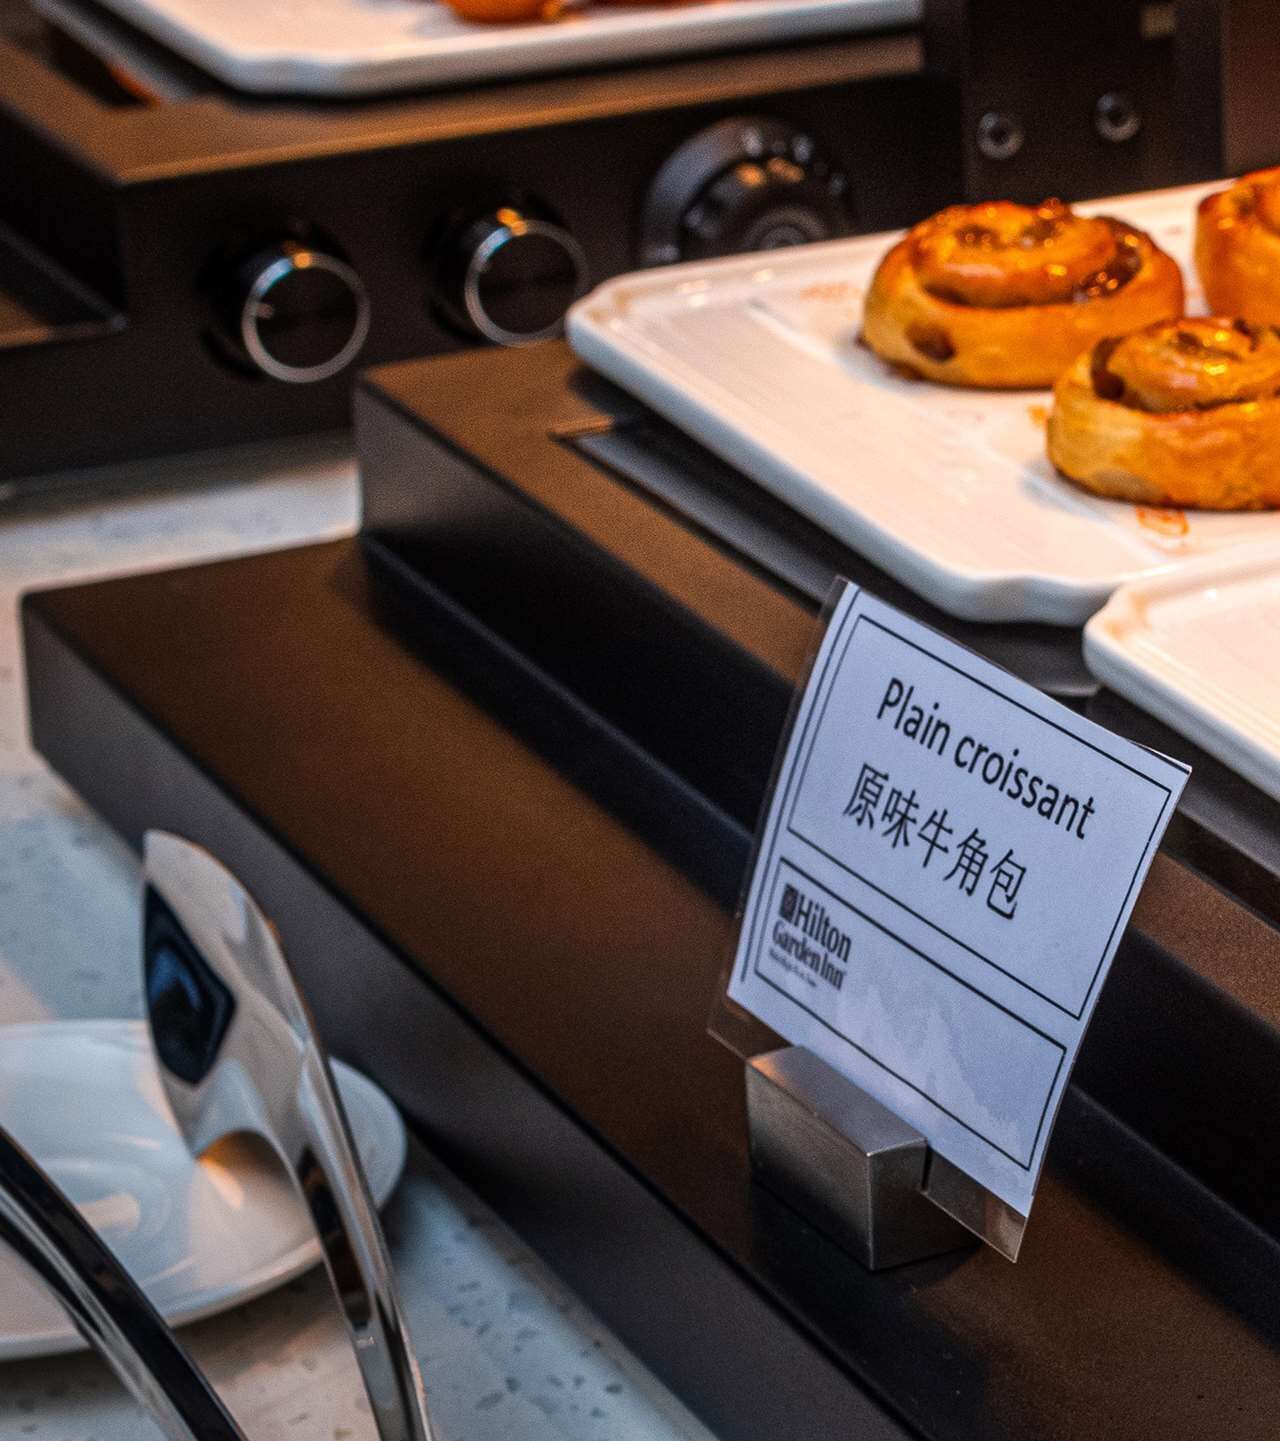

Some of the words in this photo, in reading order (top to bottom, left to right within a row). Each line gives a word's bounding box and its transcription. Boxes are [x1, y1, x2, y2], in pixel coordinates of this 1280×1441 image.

[877, 677, 951, 756] Plain
[954, 735, 1095, 840] croissant
[843, 763, 1027, 920] 原味牛角包
[772, 919, 821, 972] Garden
[794, 893, 852, 964] Hilton
